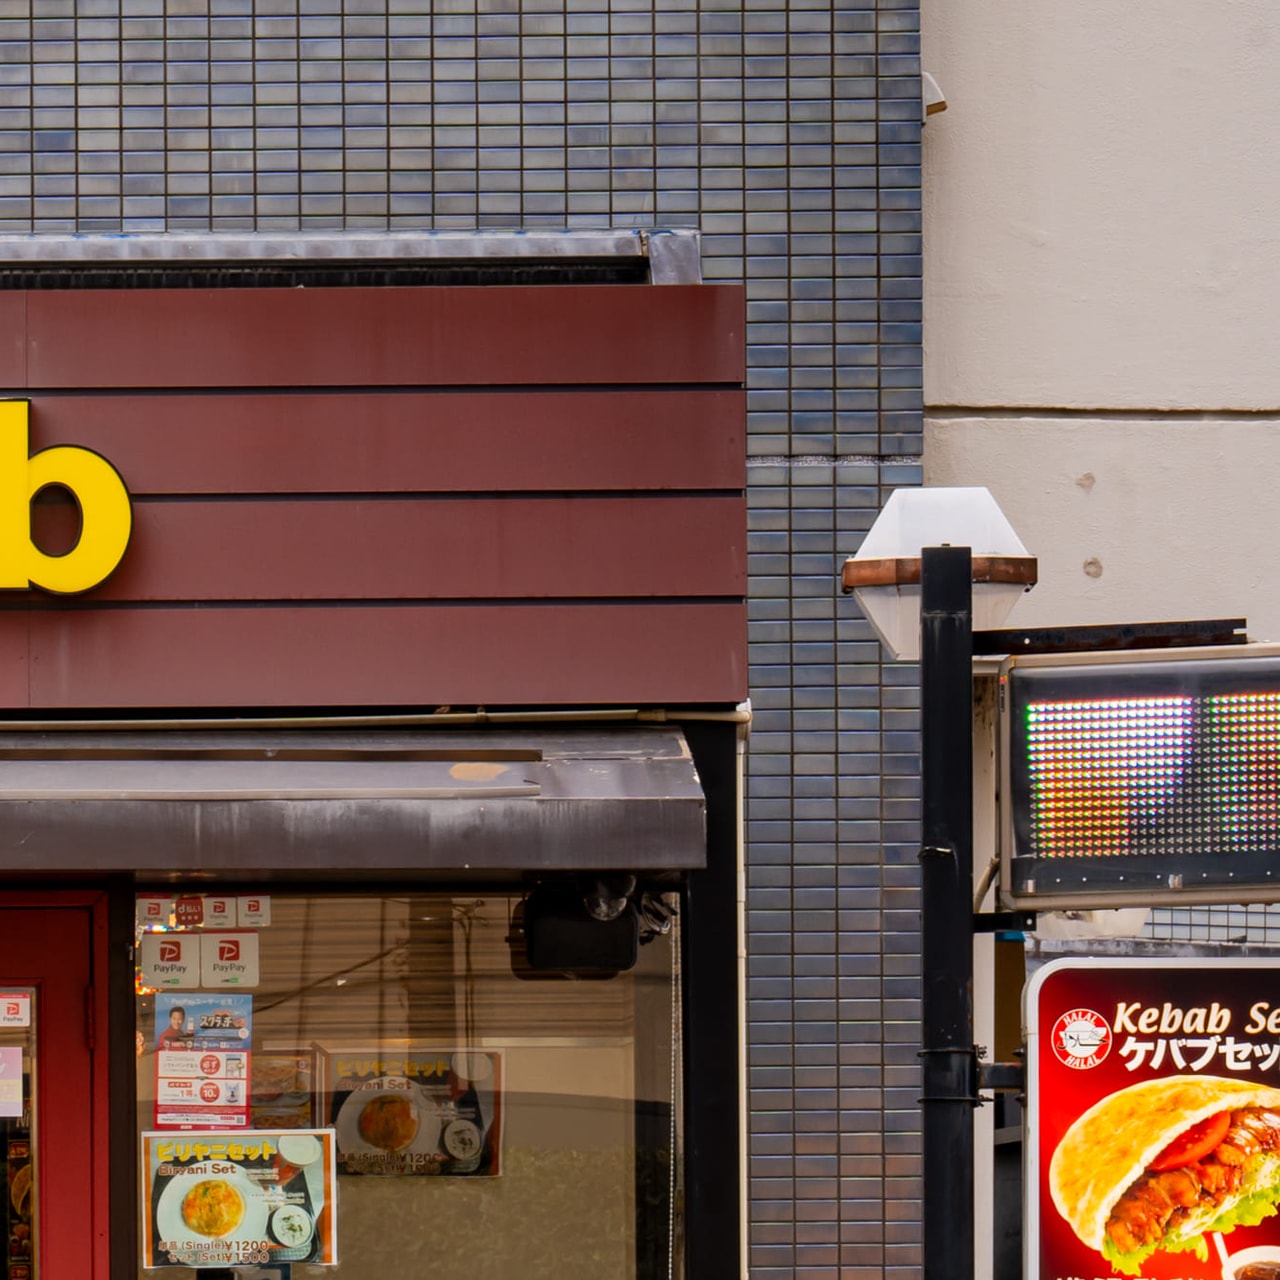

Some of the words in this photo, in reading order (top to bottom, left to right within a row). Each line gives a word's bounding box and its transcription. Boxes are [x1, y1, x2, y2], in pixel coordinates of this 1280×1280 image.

[154, 964, 187, 974] PayPay
[213, 963, 246, 973] PayPay
[1113, 1002, 1231, 1034] Kebab
[1244, 1002, 1280, 1034] Se
[156, 1142, 276, 1161] ビリヤニセット
[158, 1163, 207, 1176] Biryani
[211, 1163, 236, 1174] Set
